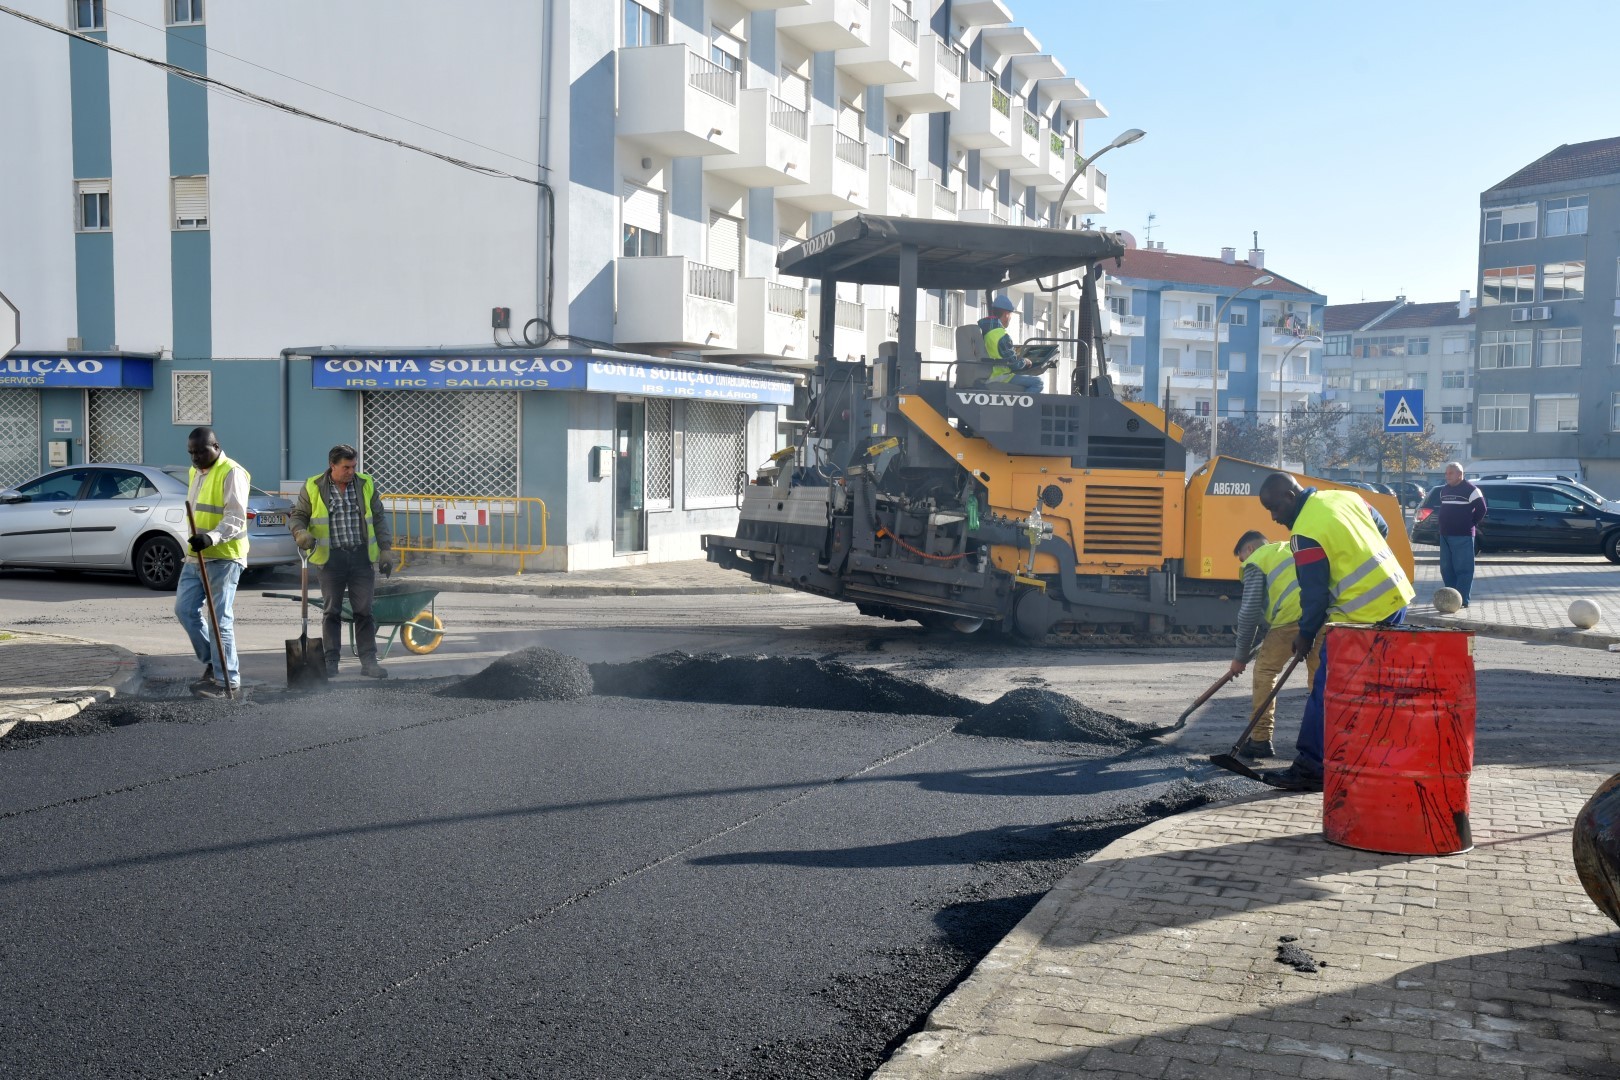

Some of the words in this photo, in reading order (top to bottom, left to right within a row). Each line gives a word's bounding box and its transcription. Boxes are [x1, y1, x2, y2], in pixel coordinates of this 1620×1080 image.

[801, 230, 835, 258] VOLVO
[324, 359, 420, 373] CONTA
[428, 357, 573, 376] SOLUÇÃO
[592, 361, 646, 378] CONTA
[649, 367, 714, 386] SOLUÇÃO
[346, 378, 377, 387] IRS
[395, 378, 427, 387] IRC
[446, 377, 549, 387] SALÁRIOS
[642, 384, 664, 393] IRS
[674, 387, 695, 395] IRC
[704, 388, 758, 400] SALÁRIOS
[955, 392, 1034, 408] VOLVO
[1213, 482, 1251, 495] ABG7820
